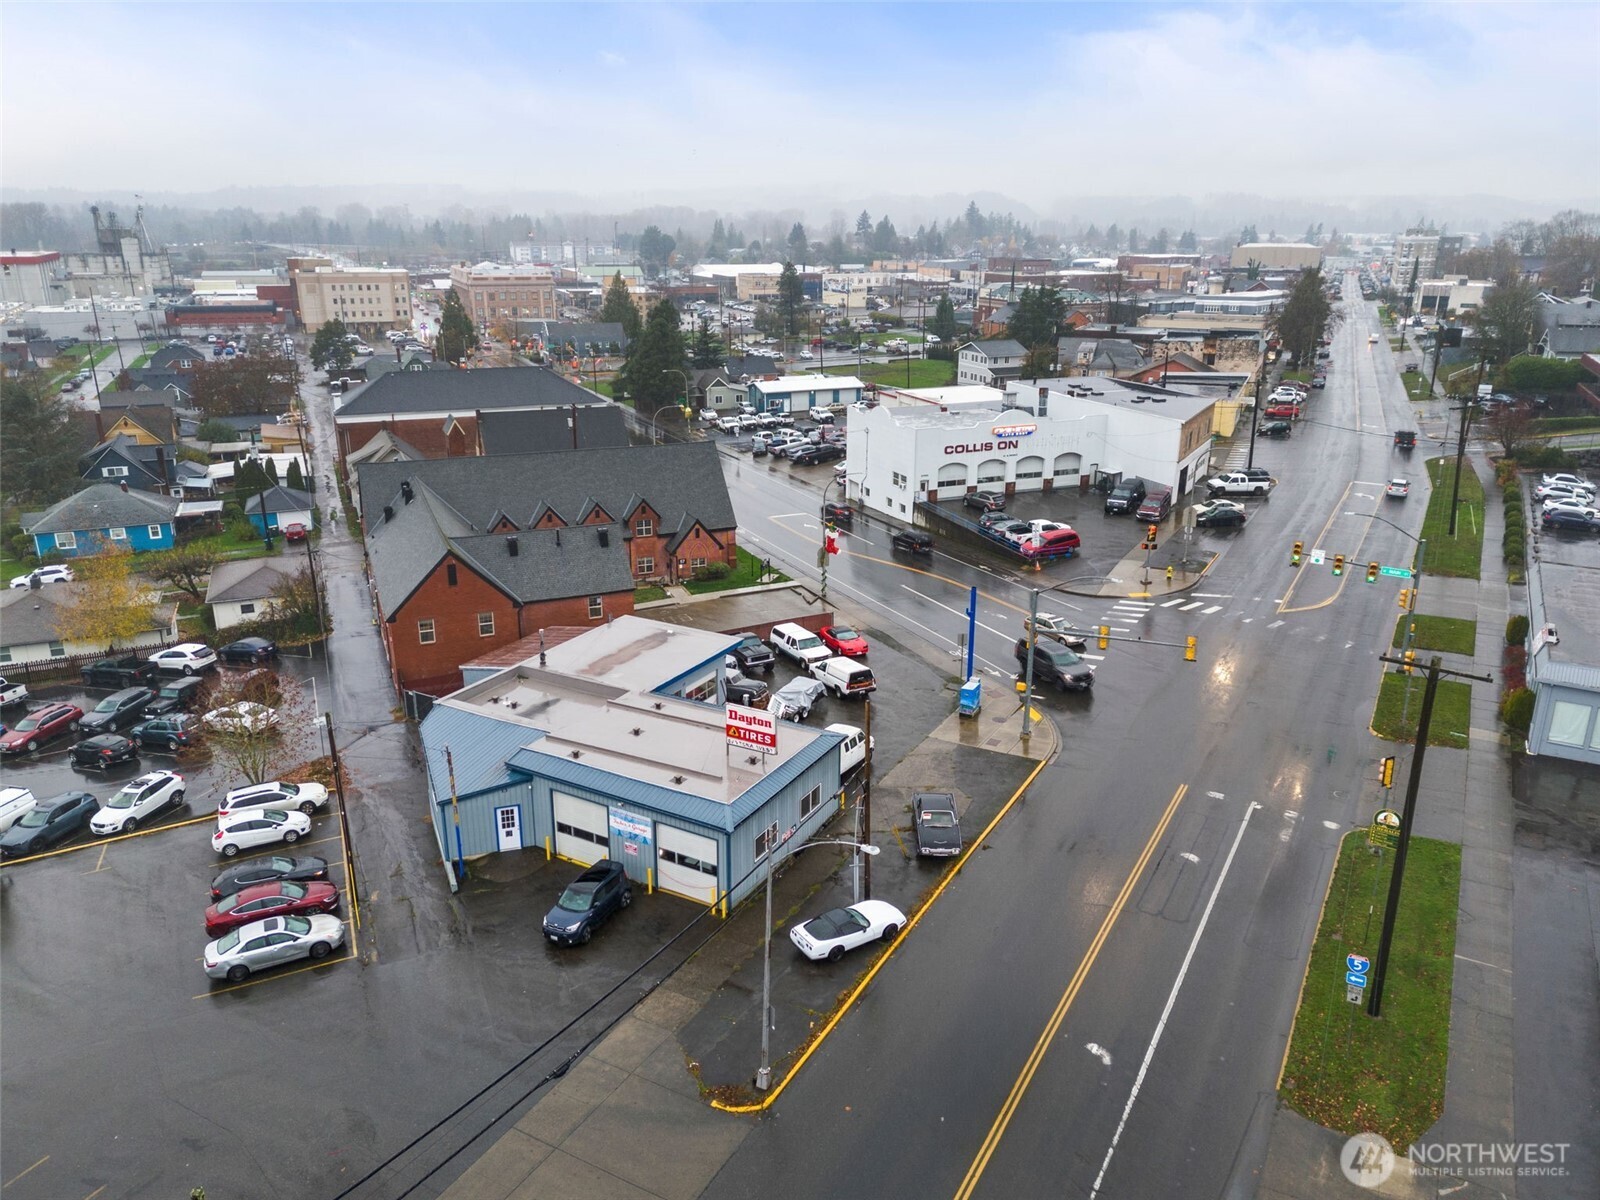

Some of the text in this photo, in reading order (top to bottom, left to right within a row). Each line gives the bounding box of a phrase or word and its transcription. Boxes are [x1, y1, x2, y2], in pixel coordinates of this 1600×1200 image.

[728, 709, 772, 728] Dayton
[739, 729, 771, 744] TIRES
[1353, 959, 1363, 970] 5
